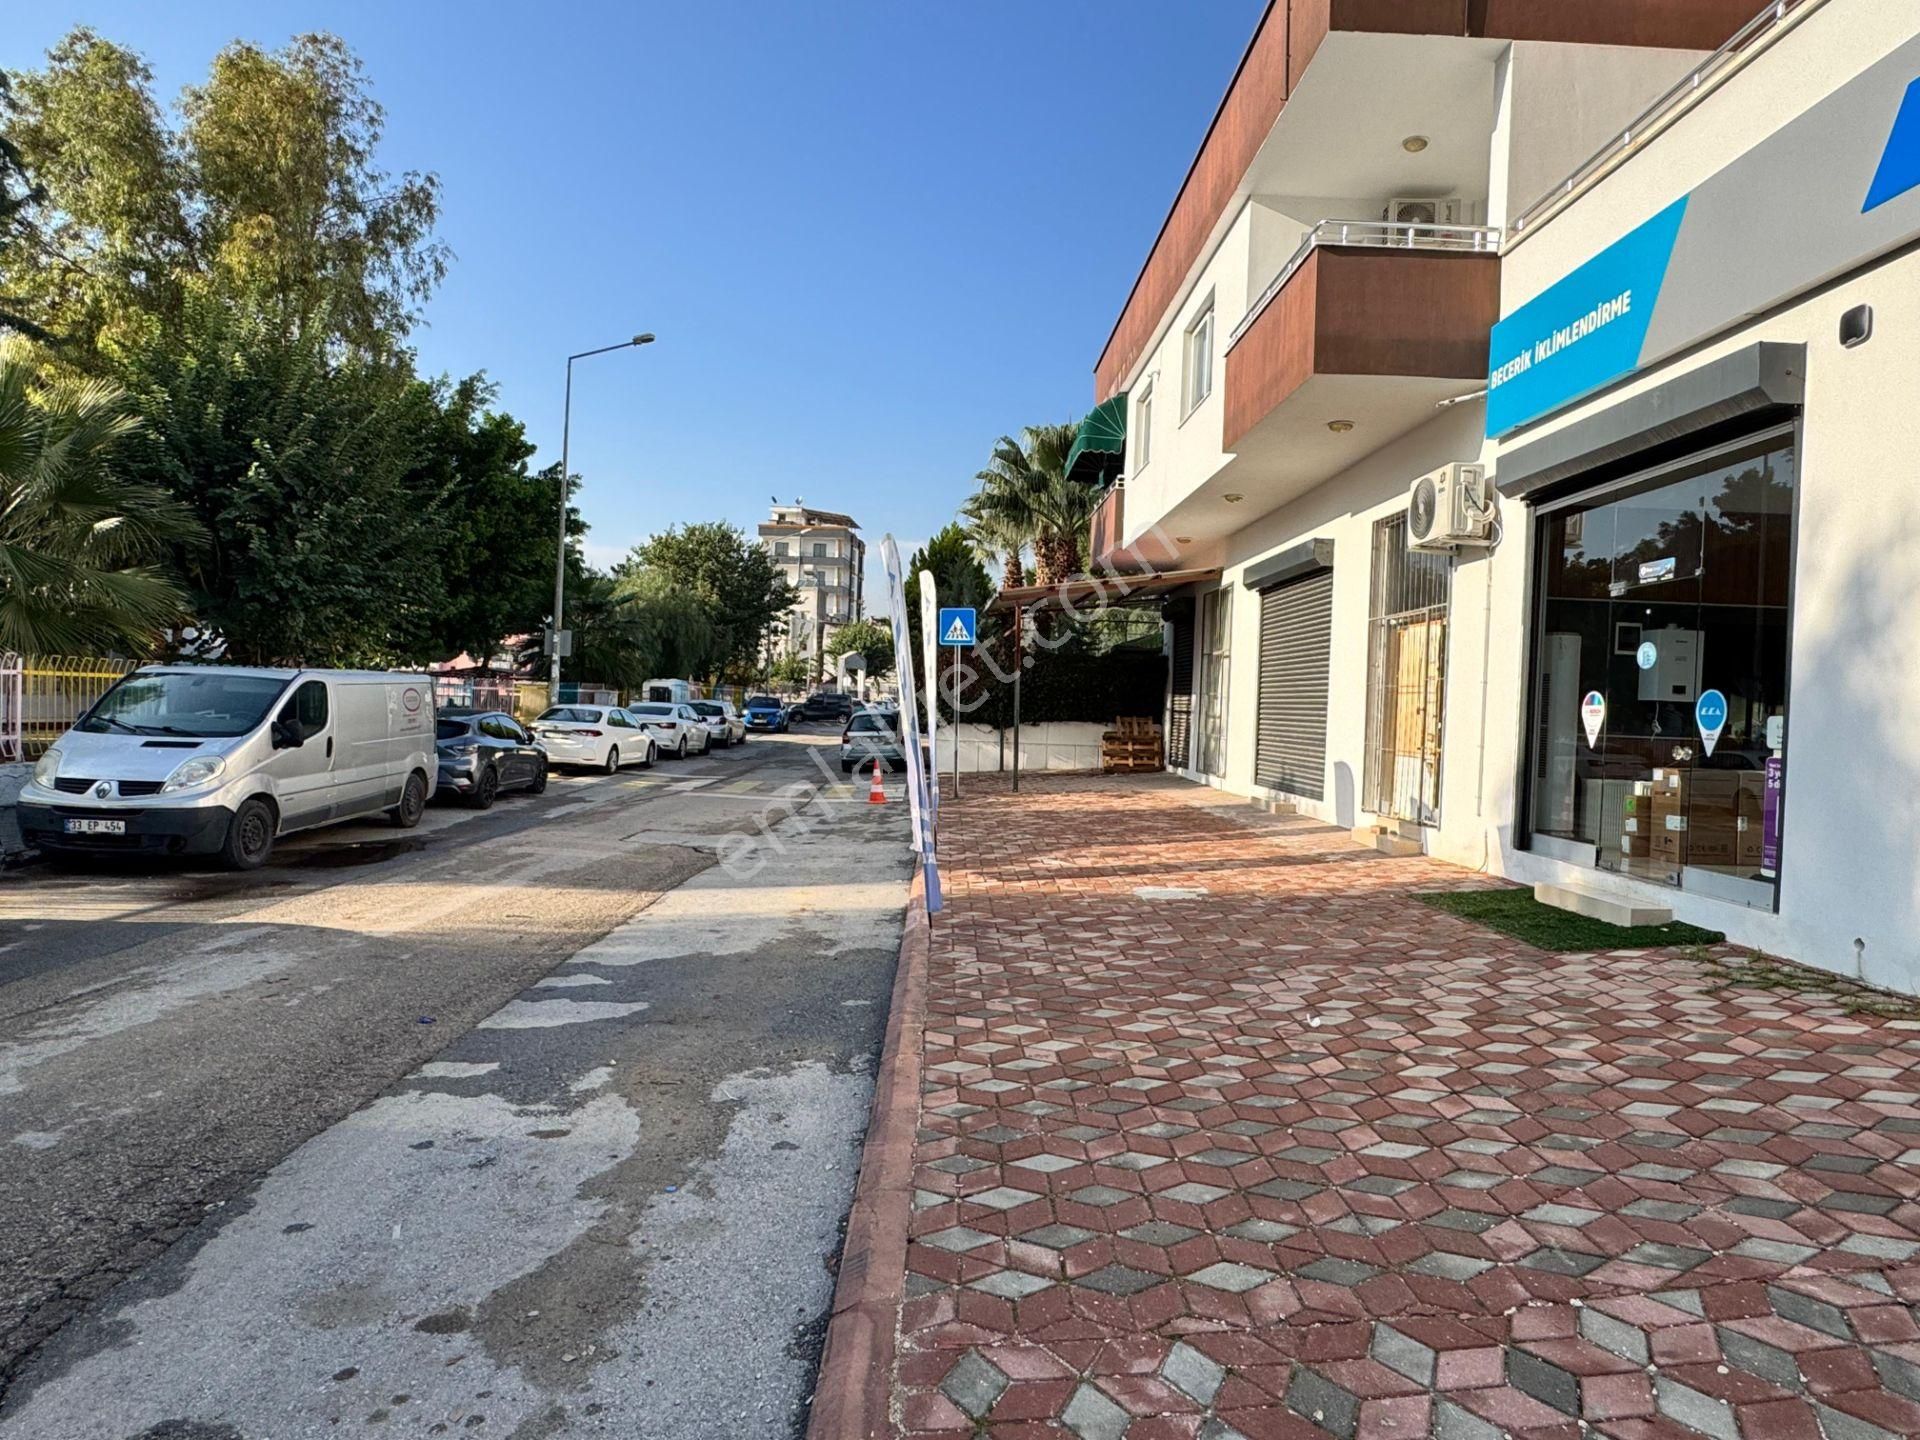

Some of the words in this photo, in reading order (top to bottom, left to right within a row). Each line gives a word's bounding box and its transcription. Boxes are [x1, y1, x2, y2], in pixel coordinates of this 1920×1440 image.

[1490, 350, 1532, 390] BECERİK
[1534, 289, 1632, 365] İKLİMLENDİRME
[71, 820, 82, 830] 33
[87, 821, 99, 831] EP
[104, 821, 122, 831] 454
